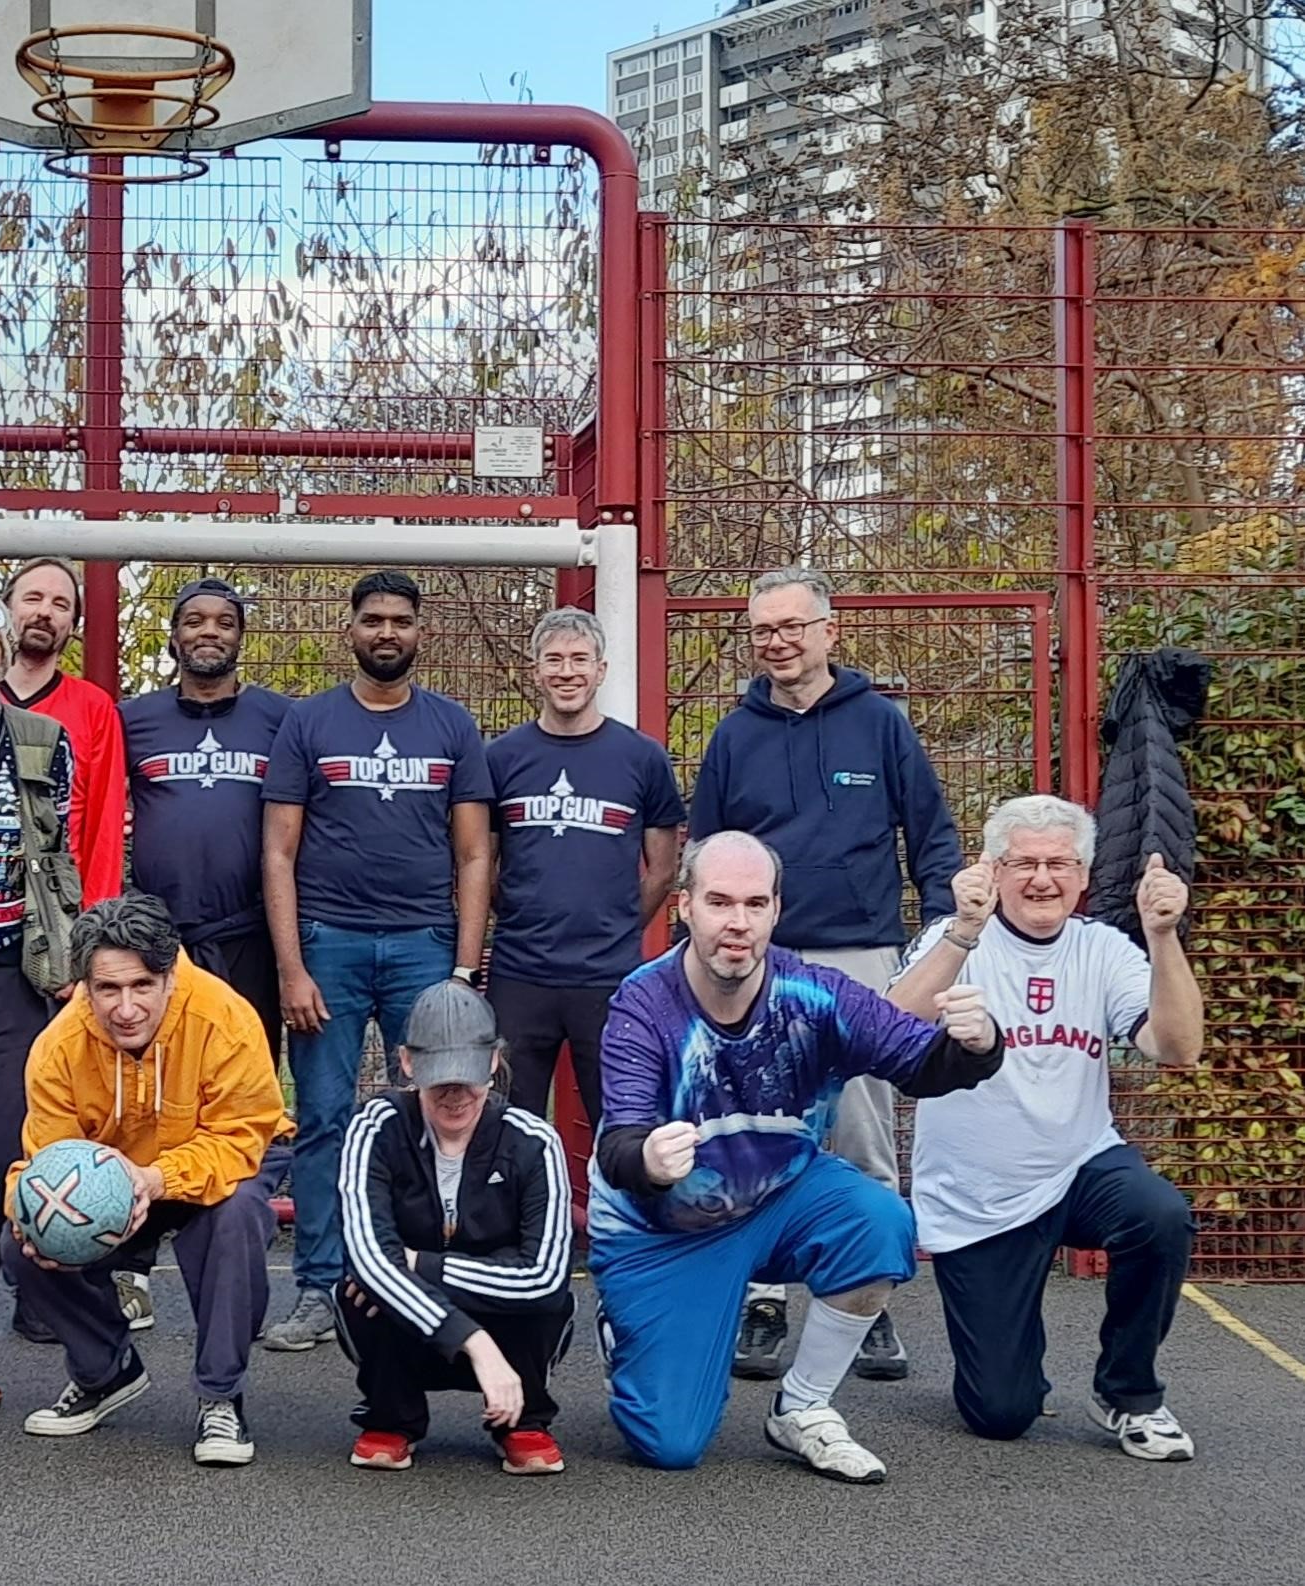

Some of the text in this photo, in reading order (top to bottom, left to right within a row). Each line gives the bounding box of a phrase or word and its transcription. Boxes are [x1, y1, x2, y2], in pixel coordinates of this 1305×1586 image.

[167, 751, 257, 776] TOP GUN
[349, 756, 430, 783] TOP GUN
[523, 795, 604, 825] TOP GUN
[1003, 1023, 1103, 1060] NGLAND
